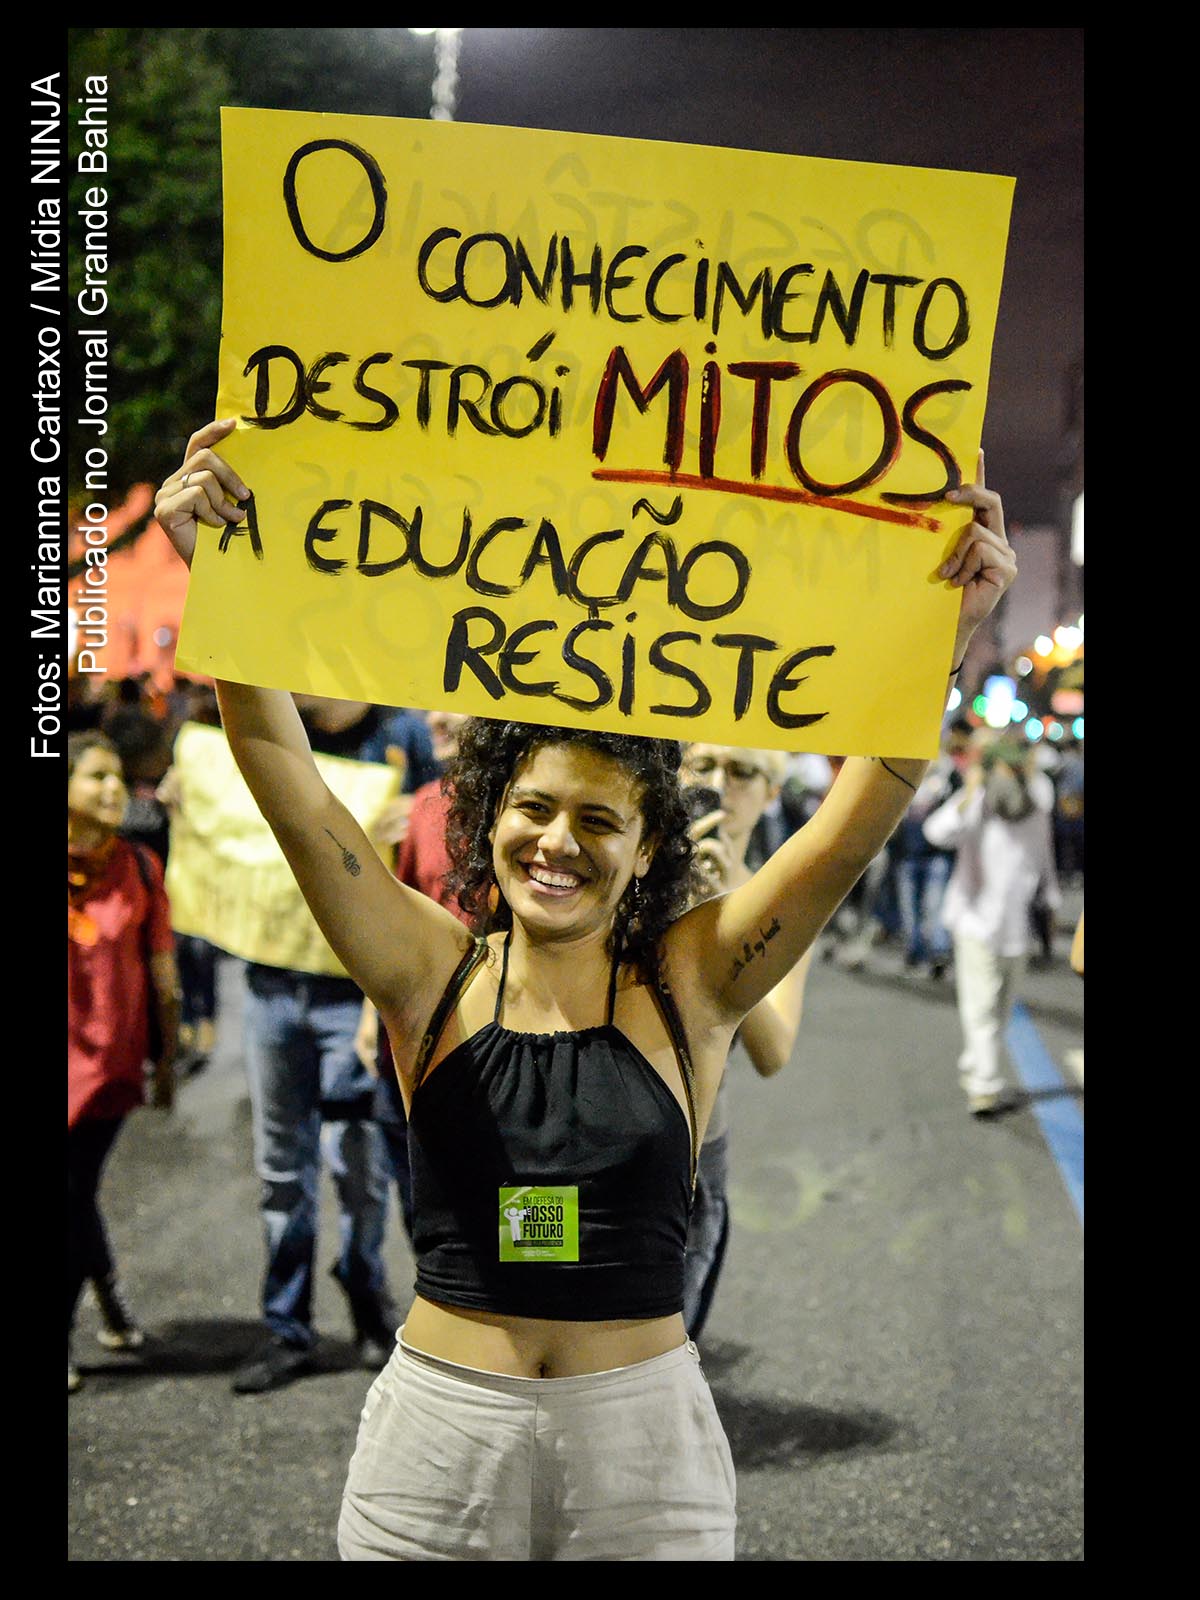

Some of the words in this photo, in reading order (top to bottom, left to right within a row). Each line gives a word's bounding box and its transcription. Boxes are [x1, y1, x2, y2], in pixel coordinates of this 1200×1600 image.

[283, 139, 388, 263] O
[217, 490, 264, 560] A
[305, 496, 751, 621] EDUCAÇÃO
[523, 1205, 563, 1222] NOSSO
[523, 1223, 563, 1239] FUTURO
